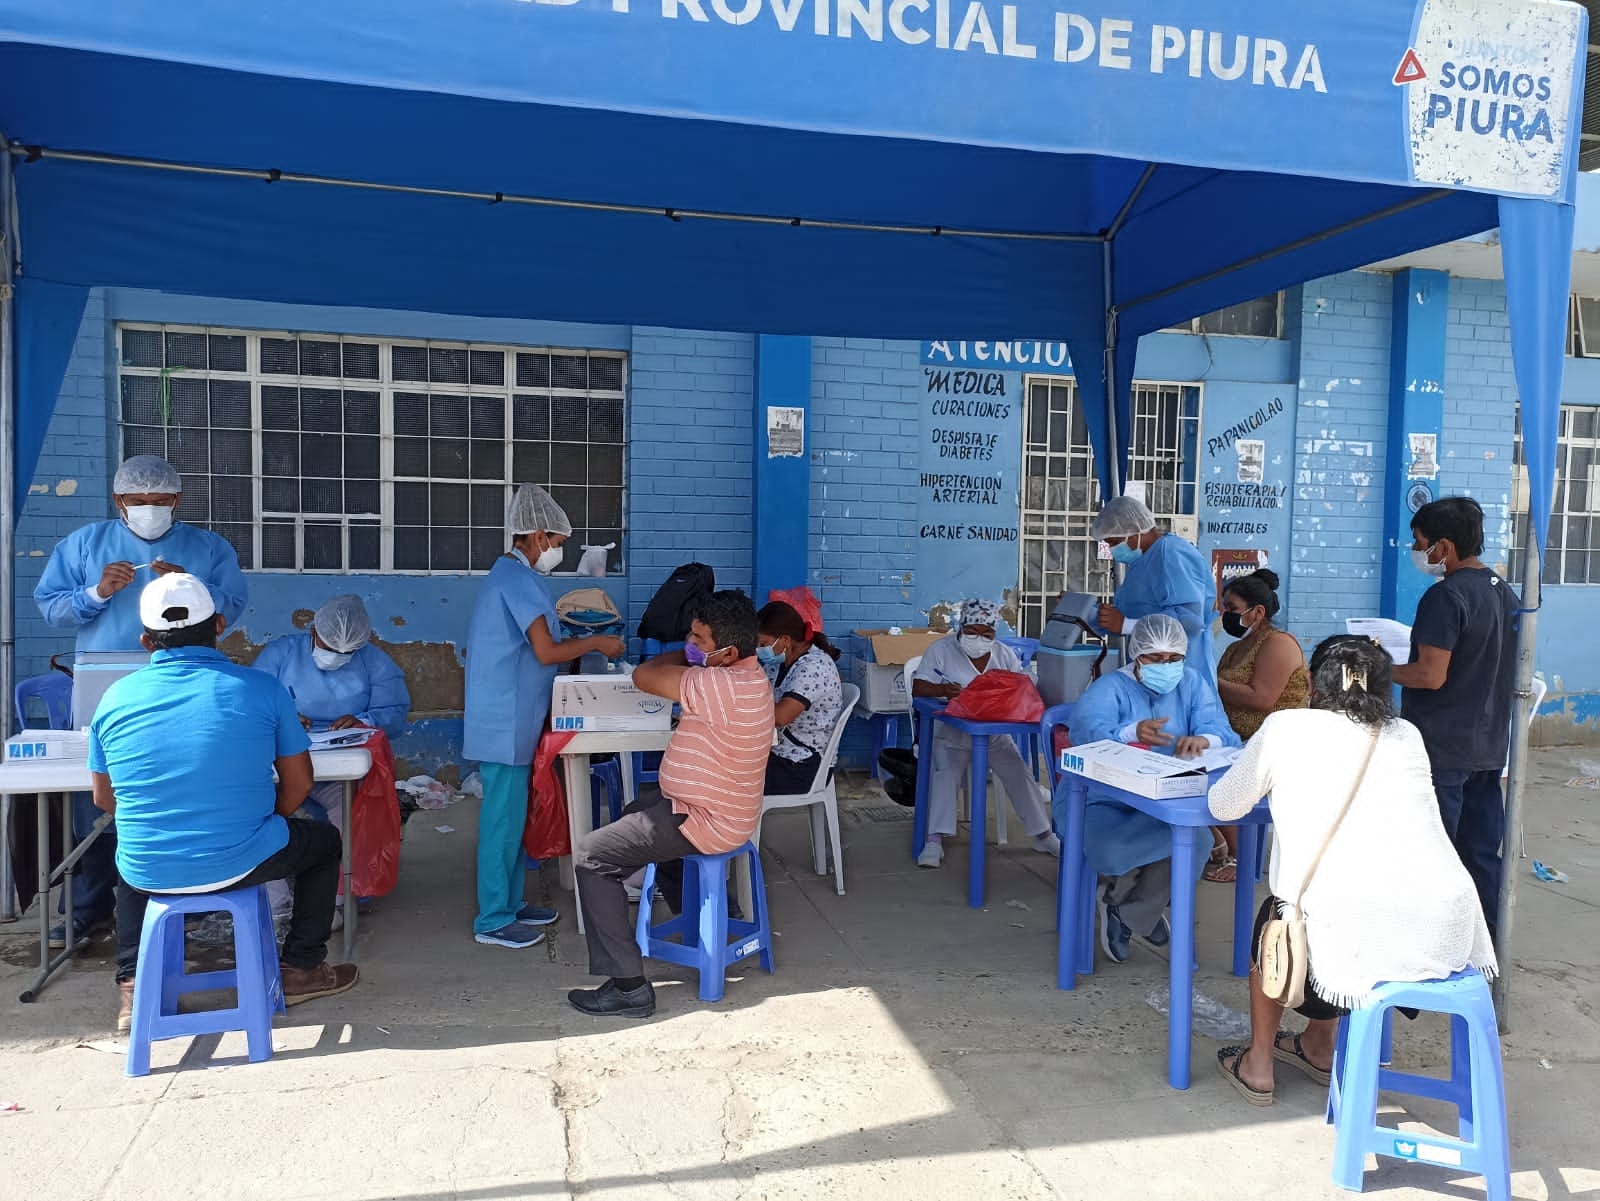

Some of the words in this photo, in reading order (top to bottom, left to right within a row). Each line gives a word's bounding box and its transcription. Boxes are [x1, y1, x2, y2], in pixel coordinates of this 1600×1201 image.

[1053, 12, 1131, 70] DE
[1150, 24, 1328, 94] PIURA
[1439, 62, 1551, 102] SOMOS
[1427, 94, 1554, 144] PIURA
[927, 340, 1073, 367] ATENCIO
[924, 367, 1006, 396] MEDICA
[932, 399, 1011, 419] CURACIONES
[1207, 397, 1284, 457] PAPANICOLAO
[932, 428, 999, 448] DESPISTAJE
[940, 446, 993, 461] DIABETES
[920, 472, 1002, 490] HIPERTENCION
[1204, 481, 1278, 497] FISIOTERAPIA
[932, 488, 999, 505] ARTERIAL
[967, 525, 1018, 542] SANIDAD
